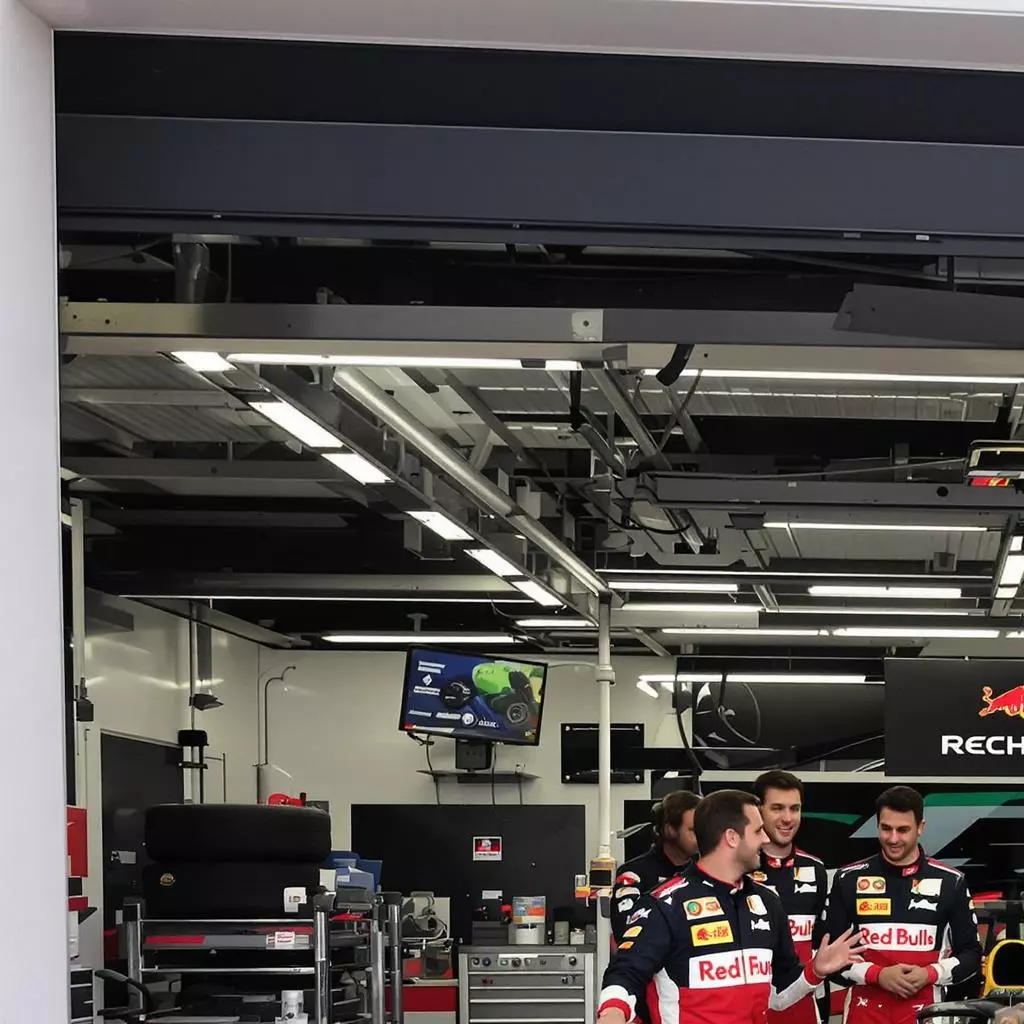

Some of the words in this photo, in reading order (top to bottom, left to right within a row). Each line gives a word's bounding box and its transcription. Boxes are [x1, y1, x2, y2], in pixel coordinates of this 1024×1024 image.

[860, 928, 893, 945] Red
[897, 929, 934, 946] Bulls
[699, 956, 741, 982] Red
